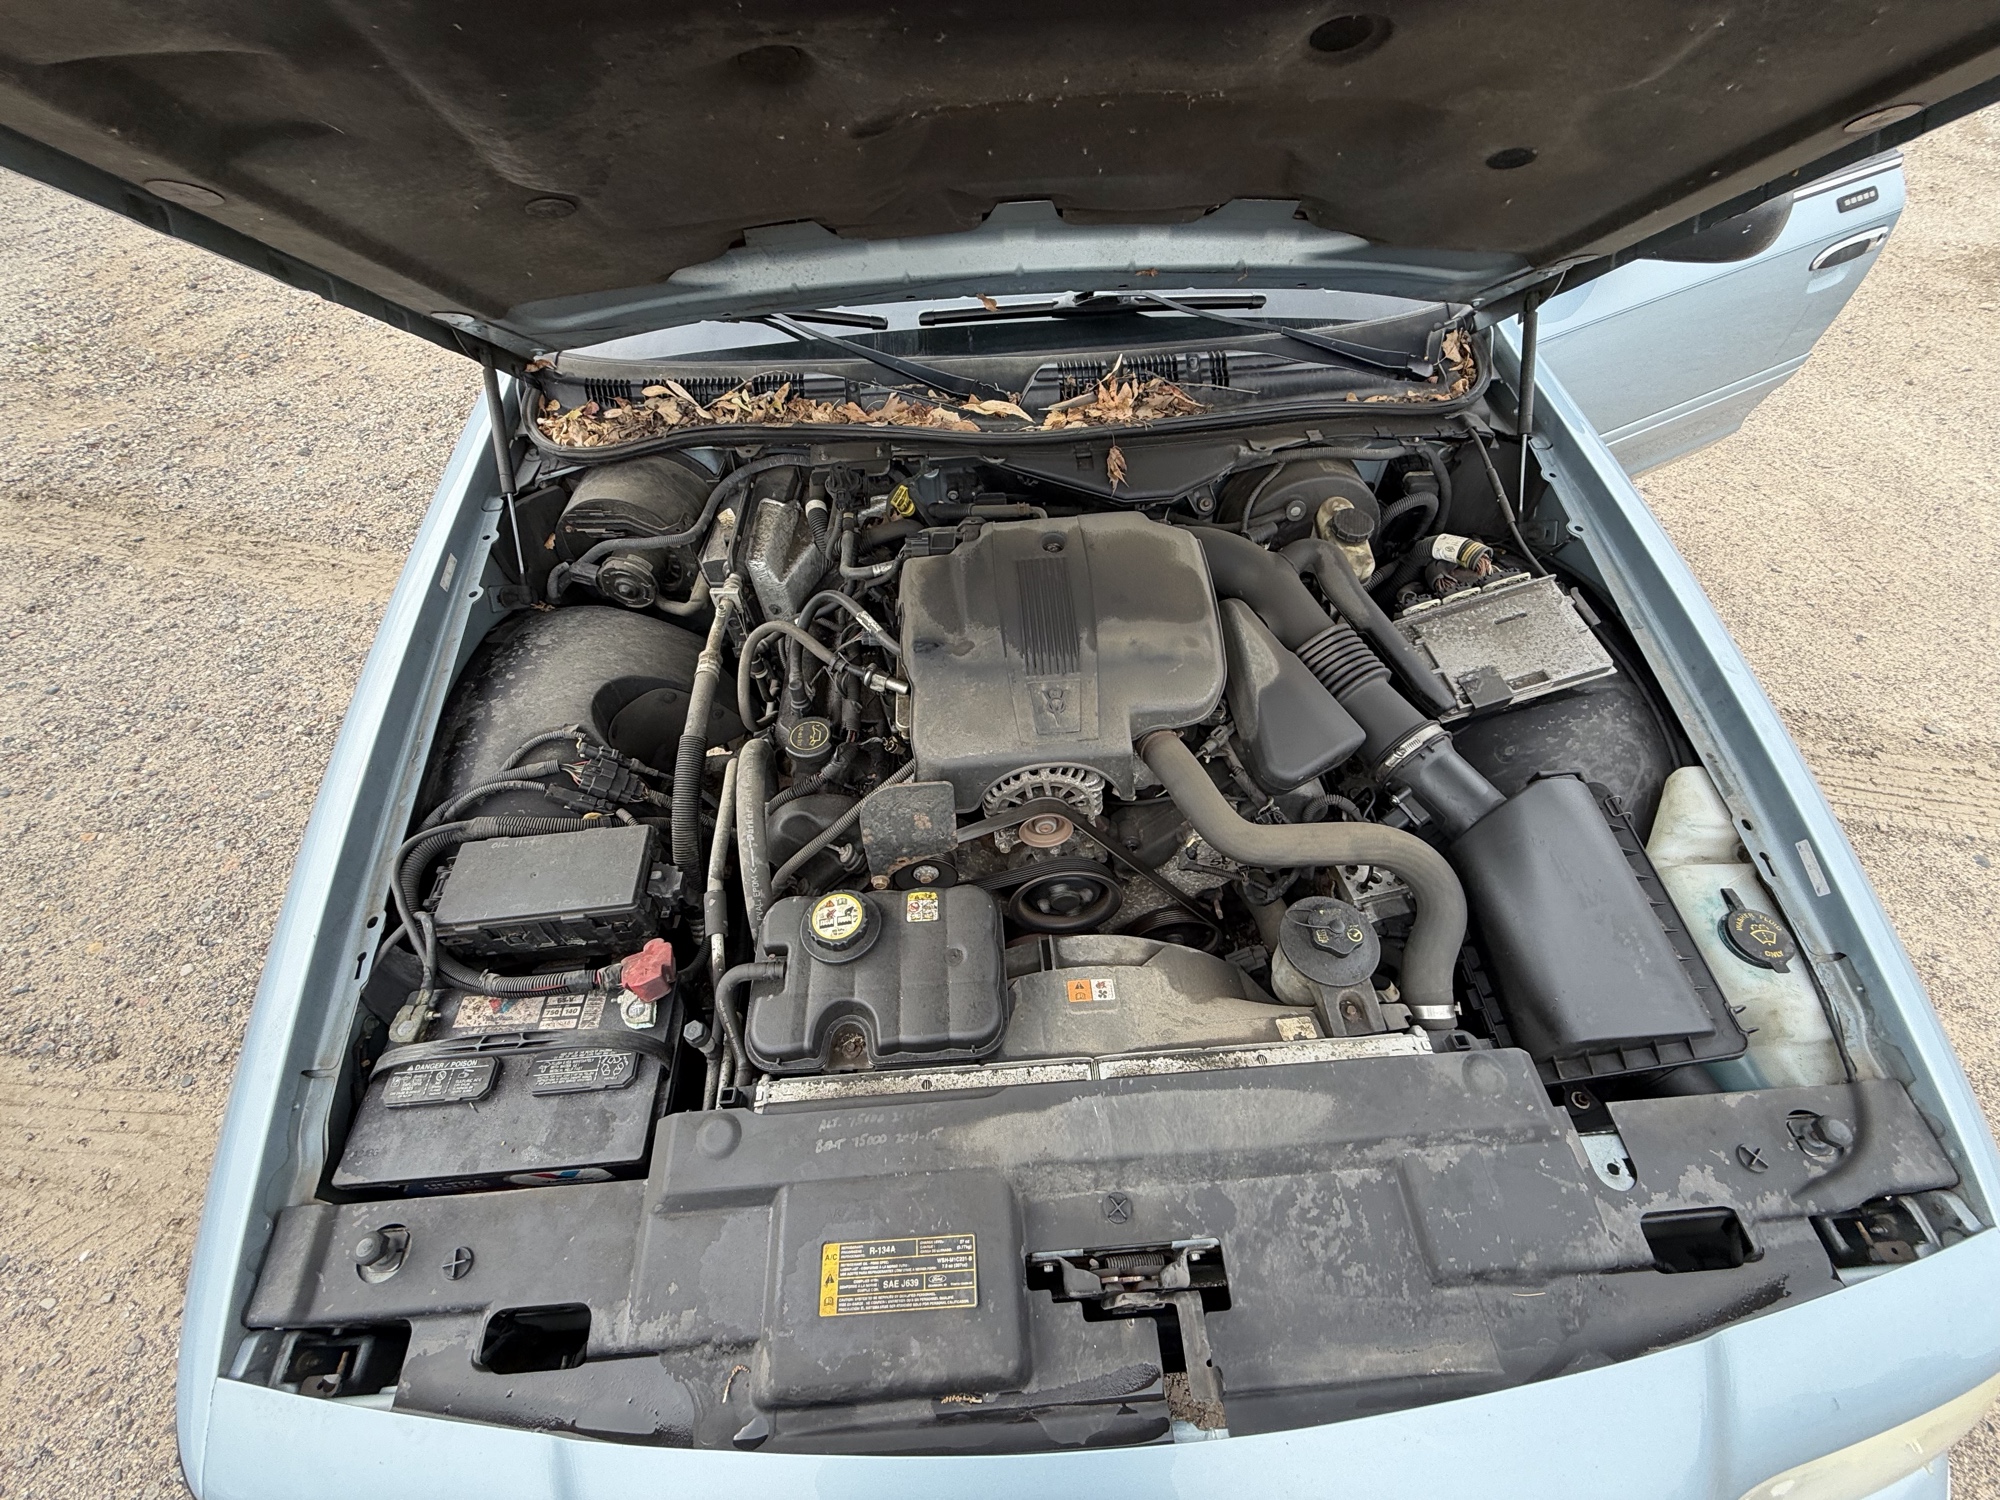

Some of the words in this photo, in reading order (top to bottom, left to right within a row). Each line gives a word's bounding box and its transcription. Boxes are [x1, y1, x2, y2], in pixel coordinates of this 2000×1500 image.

[746, 809, 754, 840] Parker
[491, 840, 508, 848] OIL
[1735, 912, 1754, 931] WASHER
[1760, 915, 1782, 931] FLUID
[1764, 950, 1784, 958] ONLY
[852, 1133, 887, 1147] 75000
[869, 1246, 896, 1255] R-134A
[883, 1280, 899, 1289] SAE
[901, 1278, 919, 1287] J639
[930, 1274, 945, 1283] Ford
